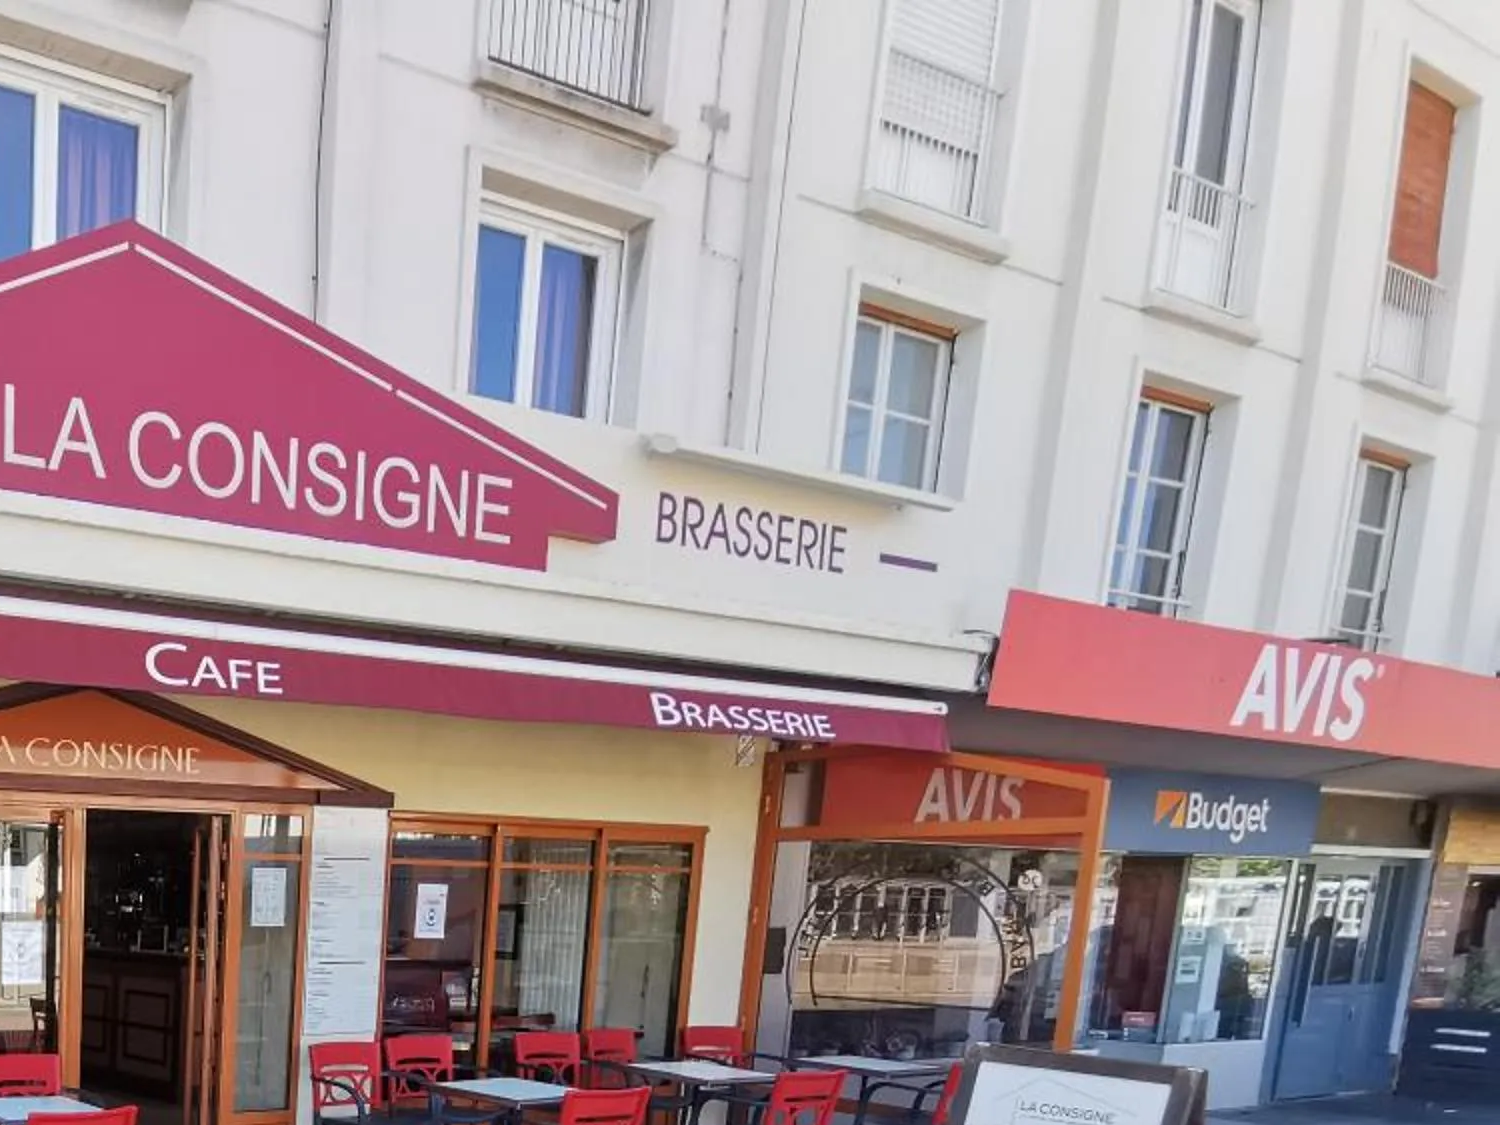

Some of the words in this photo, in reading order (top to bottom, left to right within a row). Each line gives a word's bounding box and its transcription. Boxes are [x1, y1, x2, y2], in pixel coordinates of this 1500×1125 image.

[3, 382, 106, 479] LA
[128, 410, 513, 544] CONSIGNE
[655, 491, 848, 574] BRASSERIE
[1230, 643, 1374, 741] AVIS
[25, 736, 200, 774] CONSIGNE
[914, 767, 1026, 824] AVIS
[1185, 791, 1270, 843] Budget
[1020, 1100, 1037, 1112] LA
[1039, 1102, 1115, 1125] CONSIGNE
